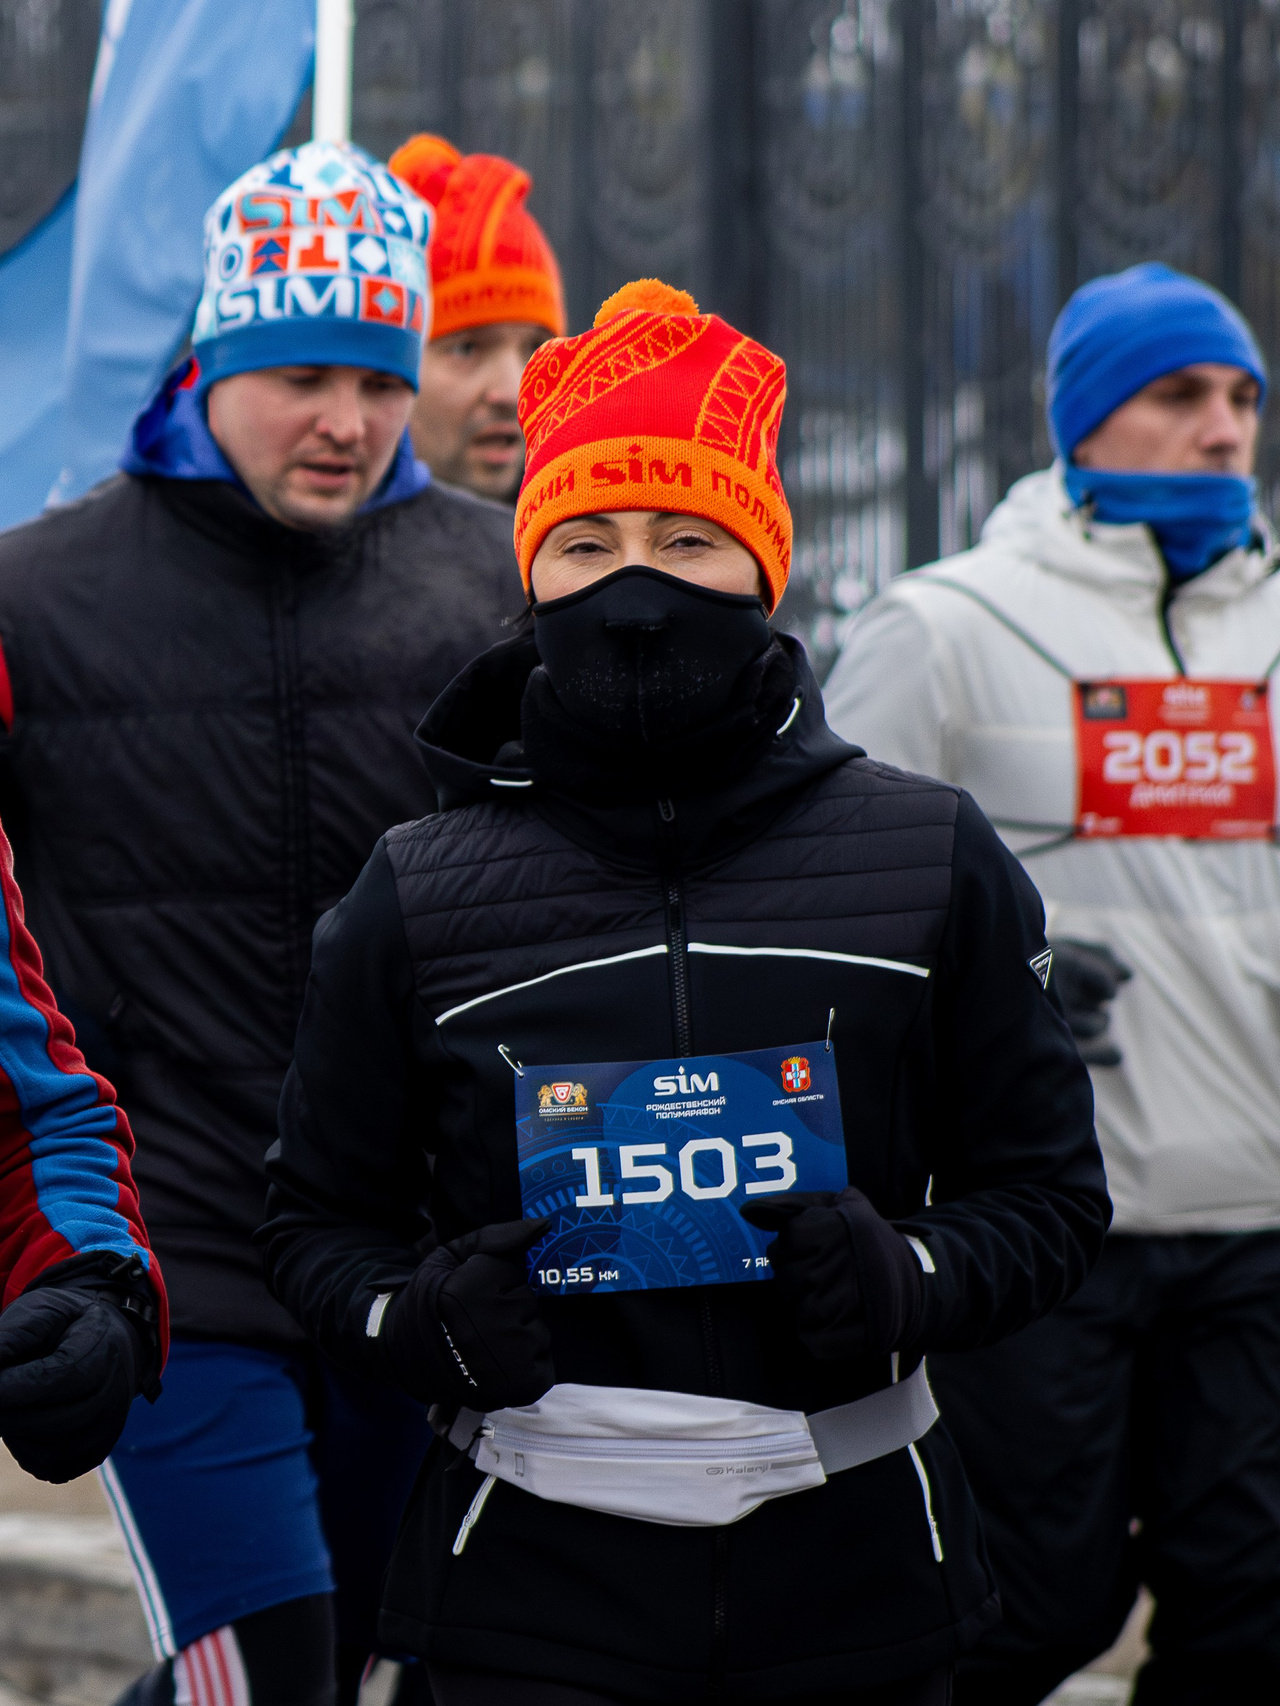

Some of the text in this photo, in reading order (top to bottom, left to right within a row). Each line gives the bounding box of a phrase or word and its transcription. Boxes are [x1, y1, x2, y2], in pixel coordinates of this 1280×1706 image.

[1103, 729, 1257, 785] 2052
[538, 1106, 566, 1114] ОМСКИЙ
[646, 1096, 726, 1112] РОЖДЕСТВЕНСКИЙ
[655, 1107, 721, 1120] ПОЛУМАРАФОН
[571, 1131, 797, 1207] 1503
[742, 1258, 751, 1268] 7
[538, 1267, 594, 1285] 10,55
